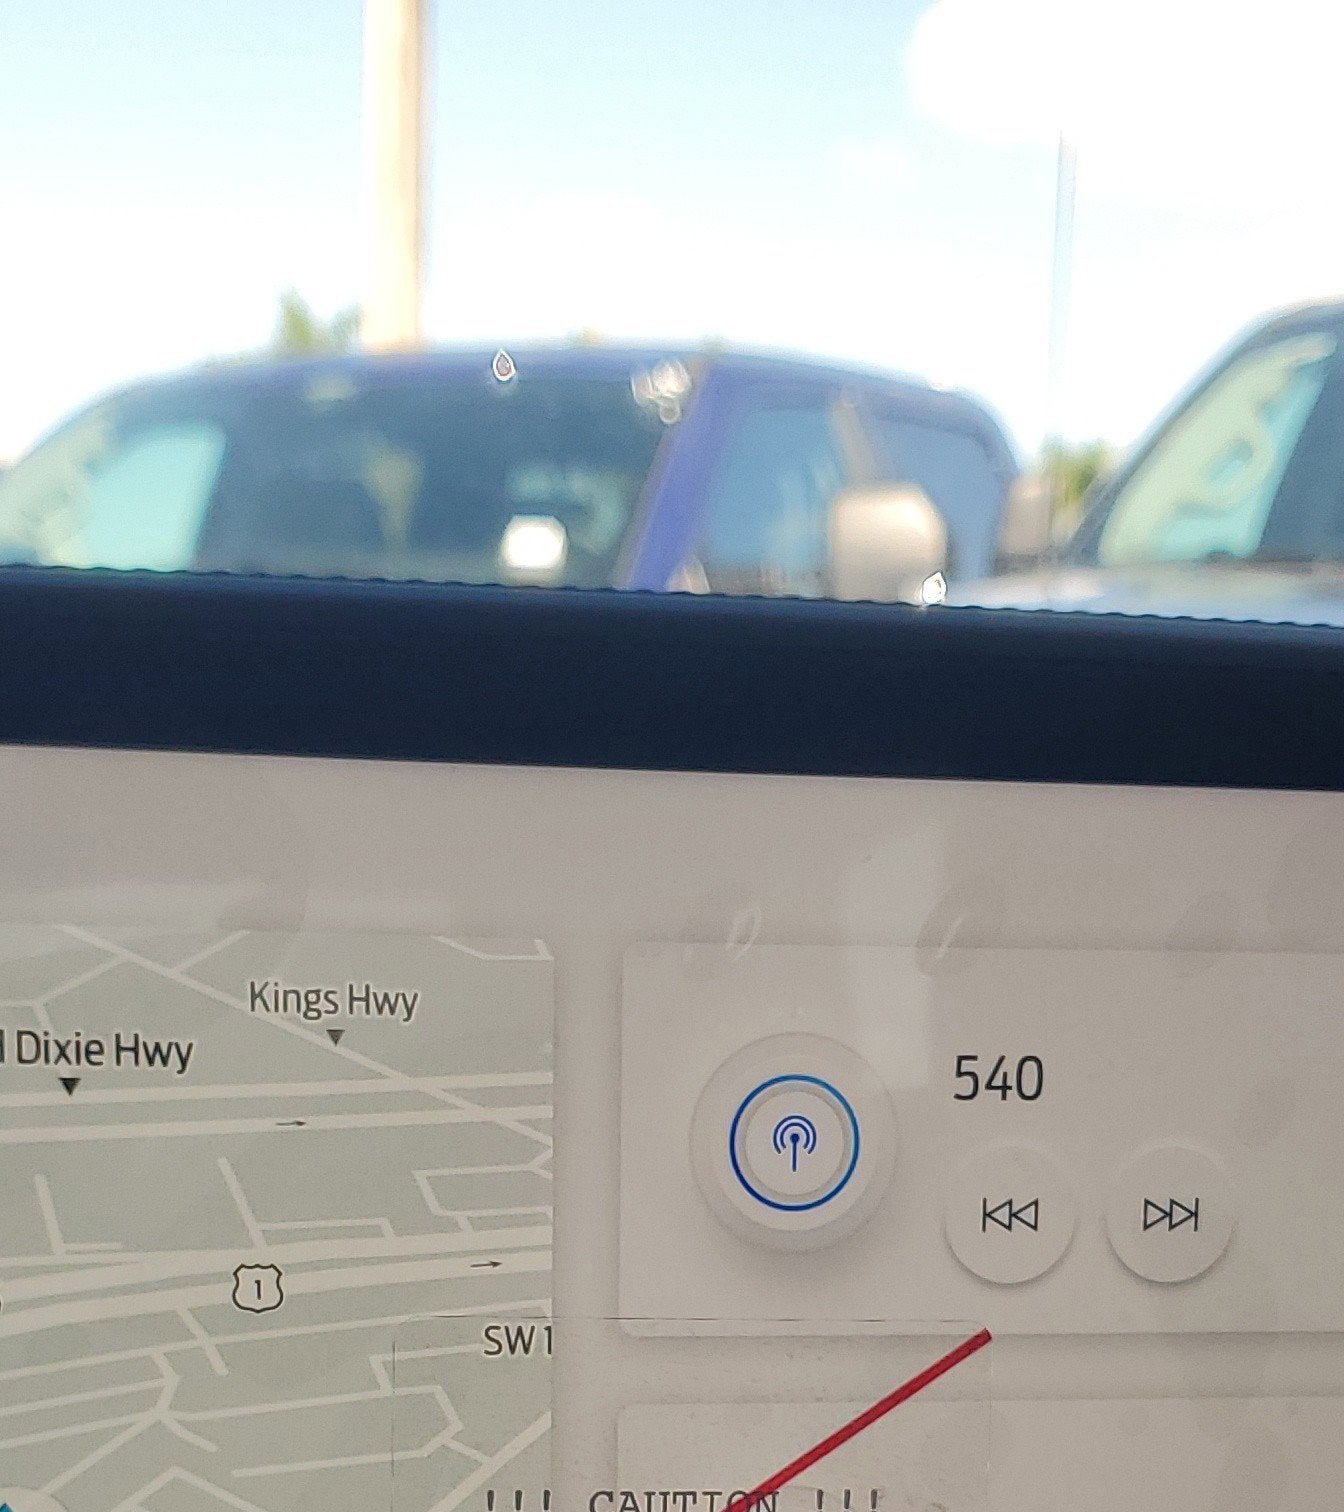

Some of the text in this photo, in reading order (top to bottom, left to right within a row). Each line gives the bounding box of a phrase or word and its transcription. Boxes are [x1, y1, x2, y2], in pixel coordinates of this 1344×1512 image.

[248, 980, 420, 1023] Kings Hwy
[15, 1032, 105, 1068] Dixie
[114, 1034, 194, 1075] Hwy
[953, 1055, 1044, 1101] 540
[483, 1325, 535, 1356] SW
